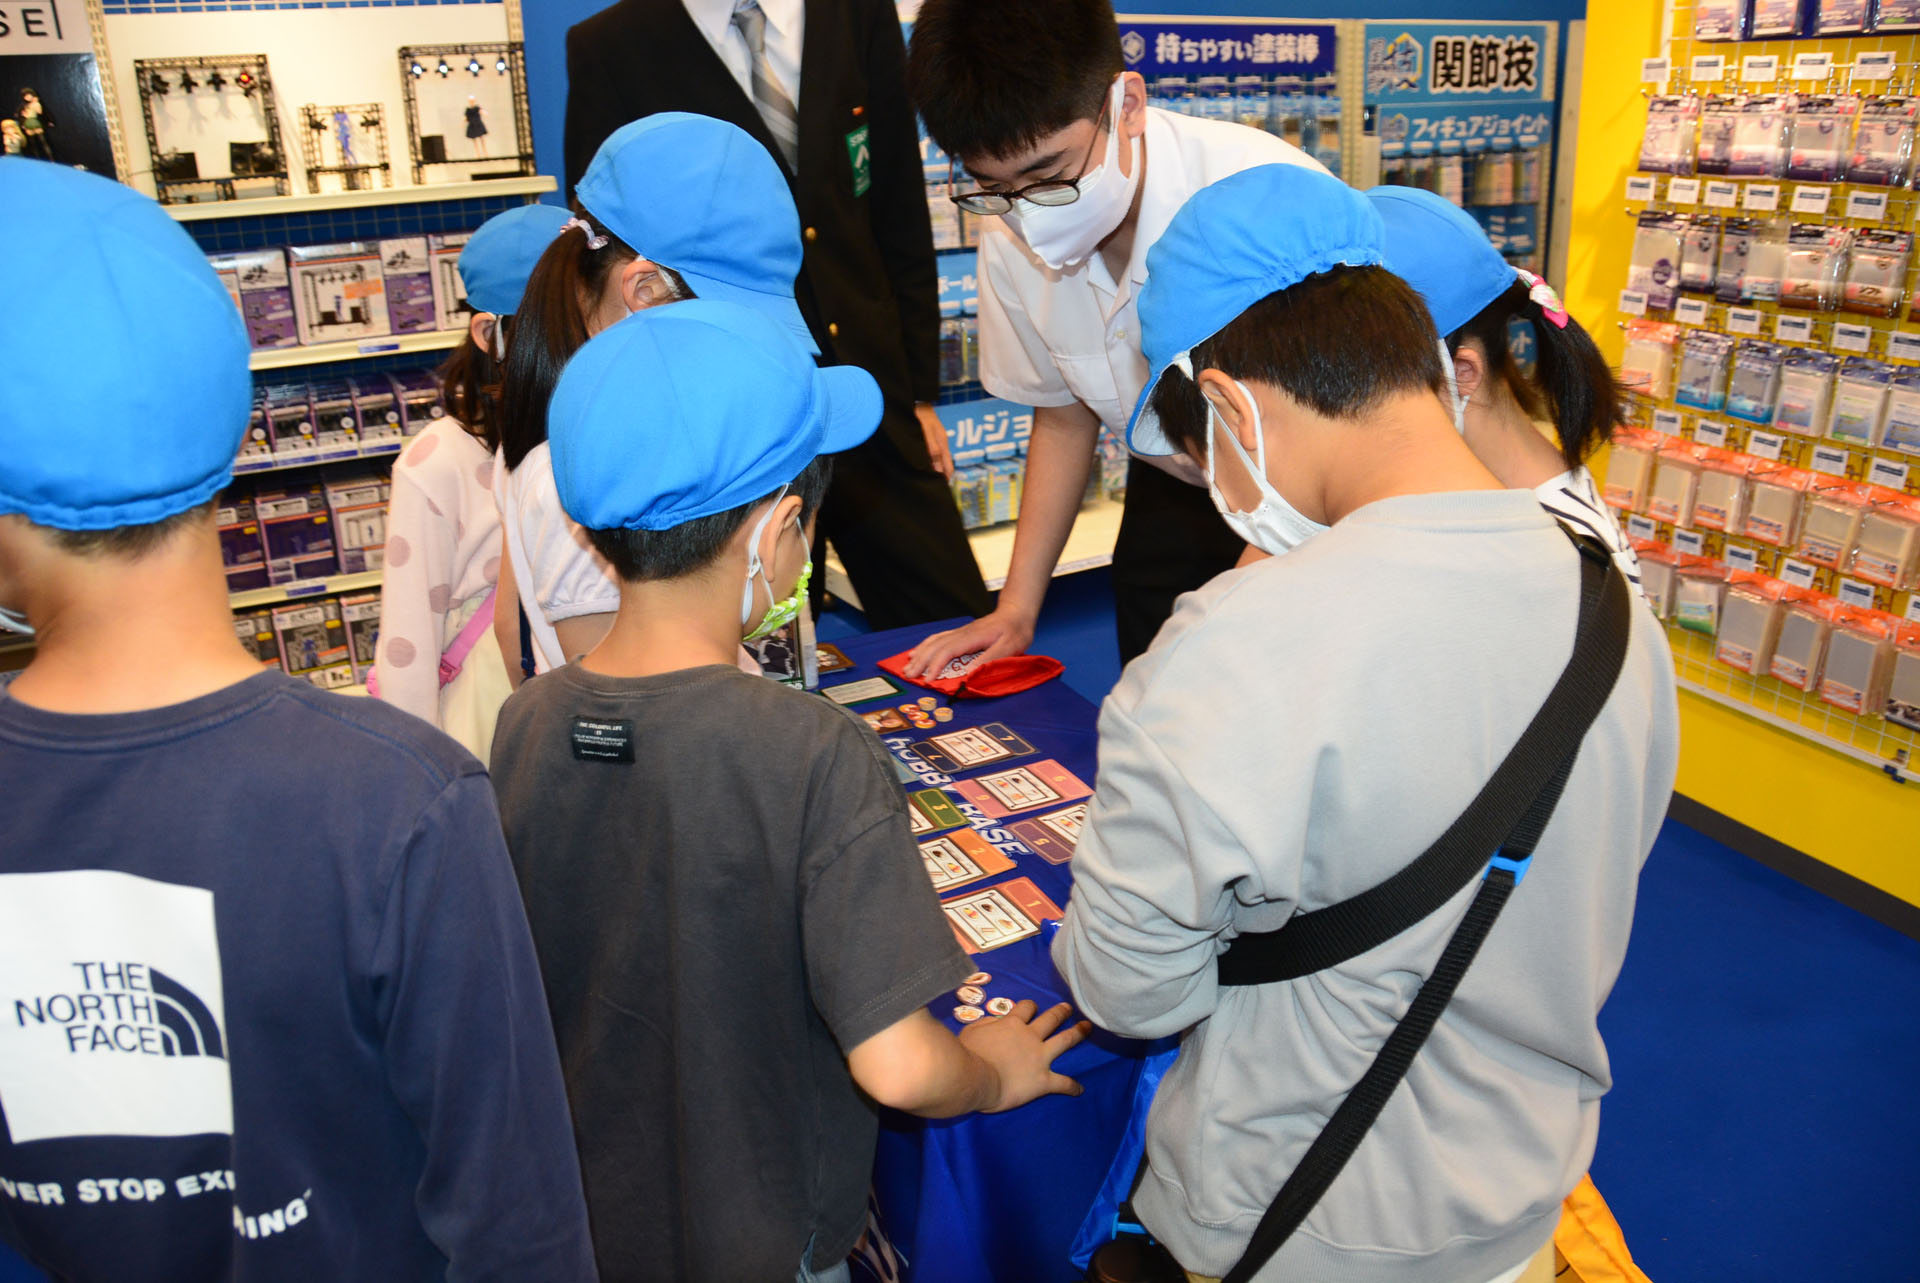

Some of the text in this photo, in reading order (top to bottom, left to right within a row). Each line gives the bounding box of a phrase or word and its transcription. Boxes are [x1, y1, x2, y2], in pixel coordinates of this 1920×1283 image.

[1432, 36, 1538, 92] 関節技
[73, 961, 148, 992] THE
[15, 993, 153, 1027] NORTH
[65, 1024, 160, 1055] FACE
[77, 1177, 165, 1203] STOP
